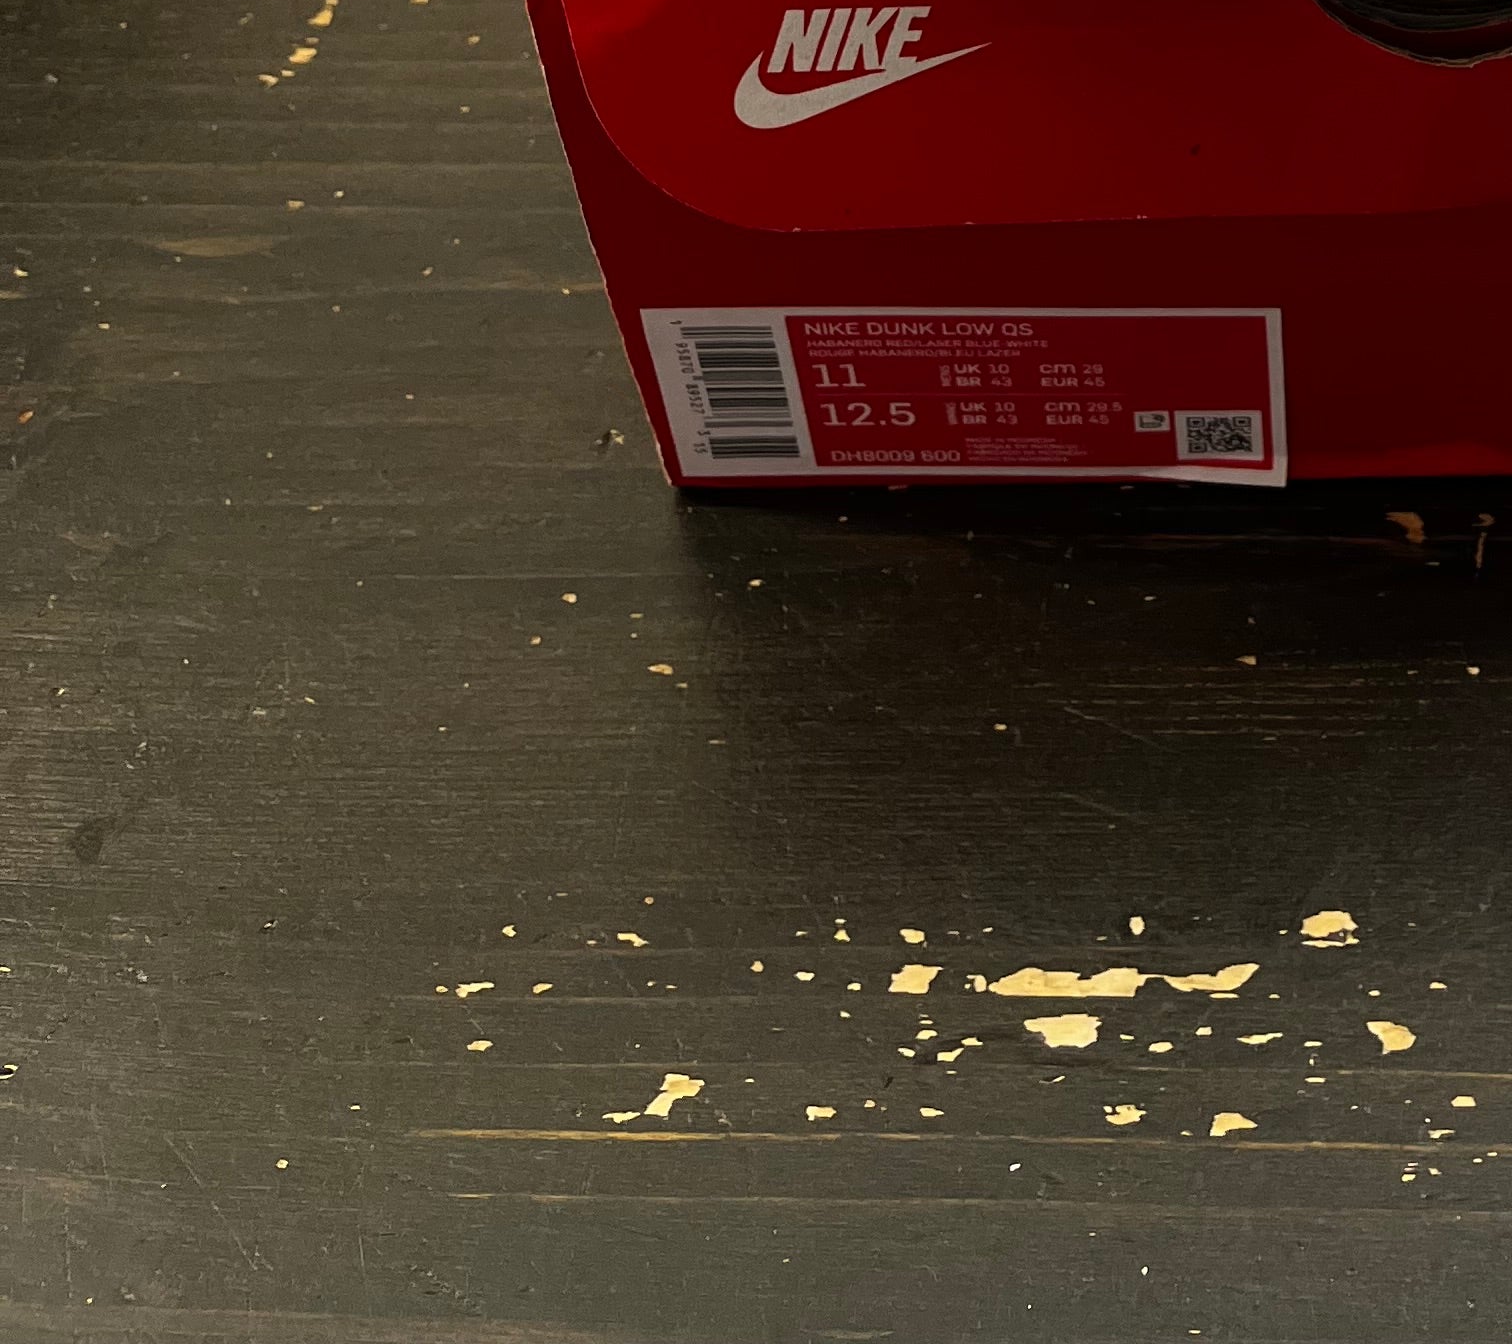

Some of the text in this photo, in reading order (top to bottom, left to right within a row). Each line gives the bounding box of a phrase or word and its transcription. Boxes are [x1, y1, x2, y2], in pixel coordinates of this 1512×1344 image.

[767, 6, 931, 73] NIKE
[804, 322, 1034, 336] NIKE DUNK LOW QS
[954, 363, 981, 374] UK
[989, 363, 1010, 374] 10
[811, 363, 866, 388] 11
[955, 376, 982, 387] BR
[991, 376, 1012, 387] 43
[1040, 376, 1078, 387] EUR
[959, 401, 987, 412] UK
[995, 401, 1015, 412] 10
[820, 402, 916, 427] 12.5
[962, 414, 987, 425] BR
[996, 414, 1018, 425] 43
[1046, 414, 1083, 425] EUR
[920, 449, 961, 462] 600
